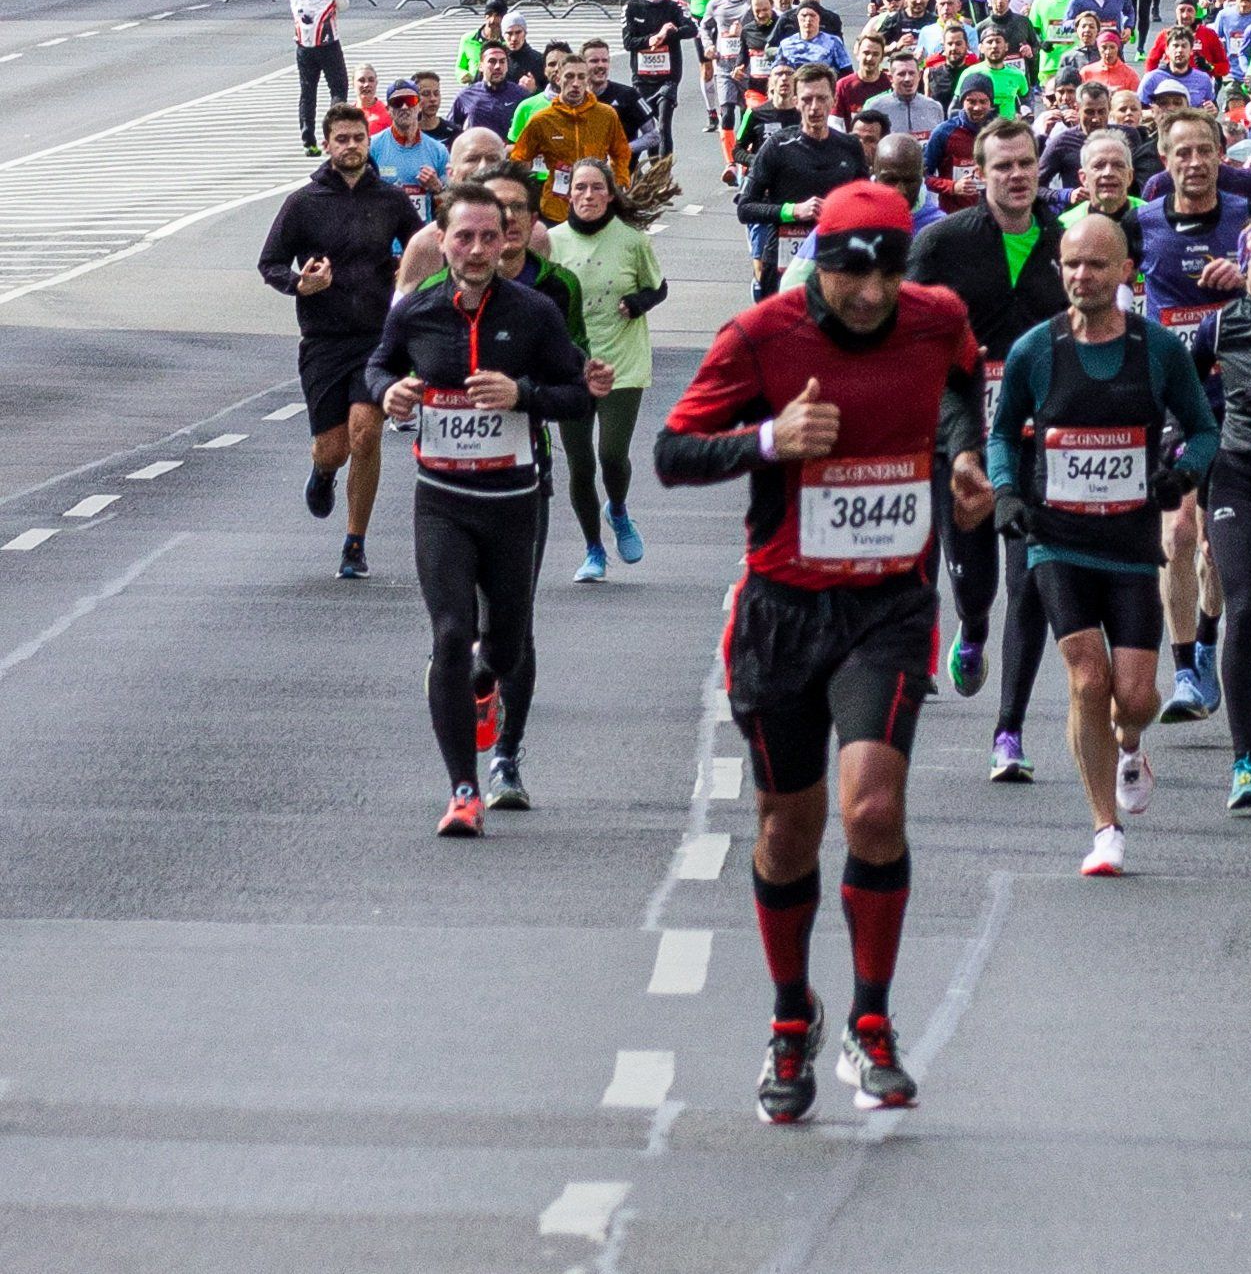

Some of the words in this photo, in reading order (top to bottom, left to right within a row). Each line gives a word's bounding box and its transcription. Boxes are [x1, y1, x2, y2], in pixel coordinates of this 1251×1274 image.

[439, 414, 503, 439] 18452
[456, 441, 484, 450] Kevin
[1077, 432, 1132, 445] GENERALI
[846, 461, 915, 480] GENERALI
[1067, 455, 1134, 480] 54423
[830, 493, 918, 528] 38448
